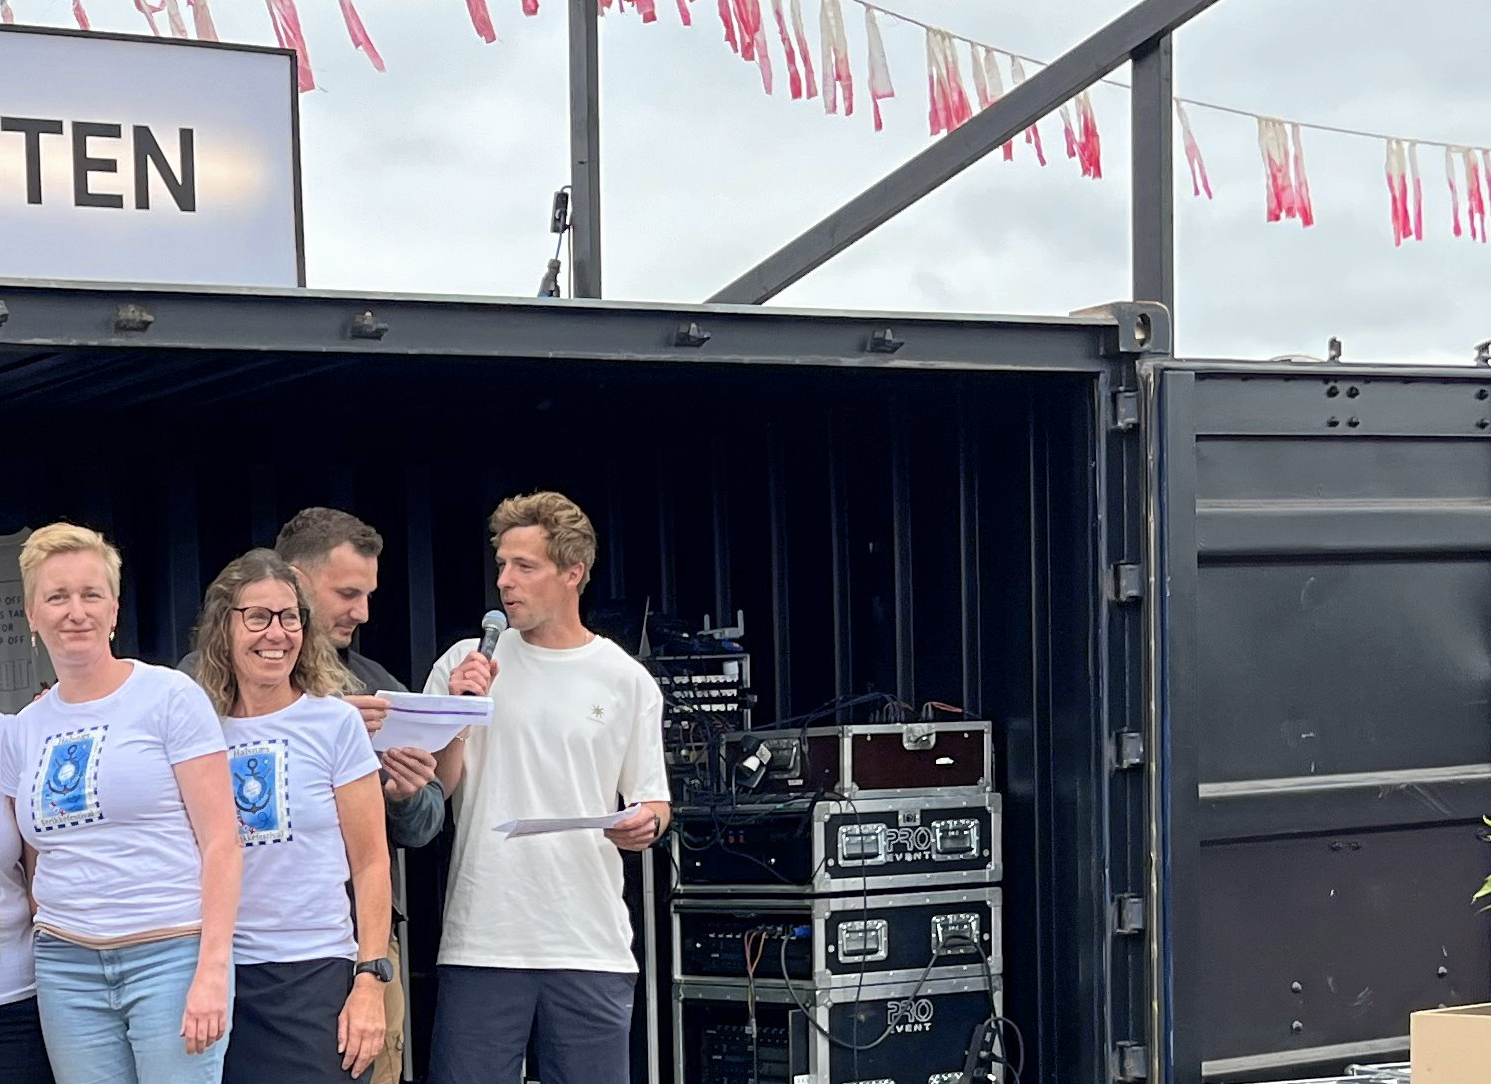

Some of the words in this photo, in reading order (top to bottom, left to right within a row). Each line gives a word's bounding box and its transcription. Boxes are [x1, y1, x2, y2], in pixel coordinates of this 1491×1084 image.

[8, 636, 25, 645] OFF
[886, 826, 932, 852] PRO
[886, 851, 931, 862] EVENT
[886, 998, 933, 1025] PRO
